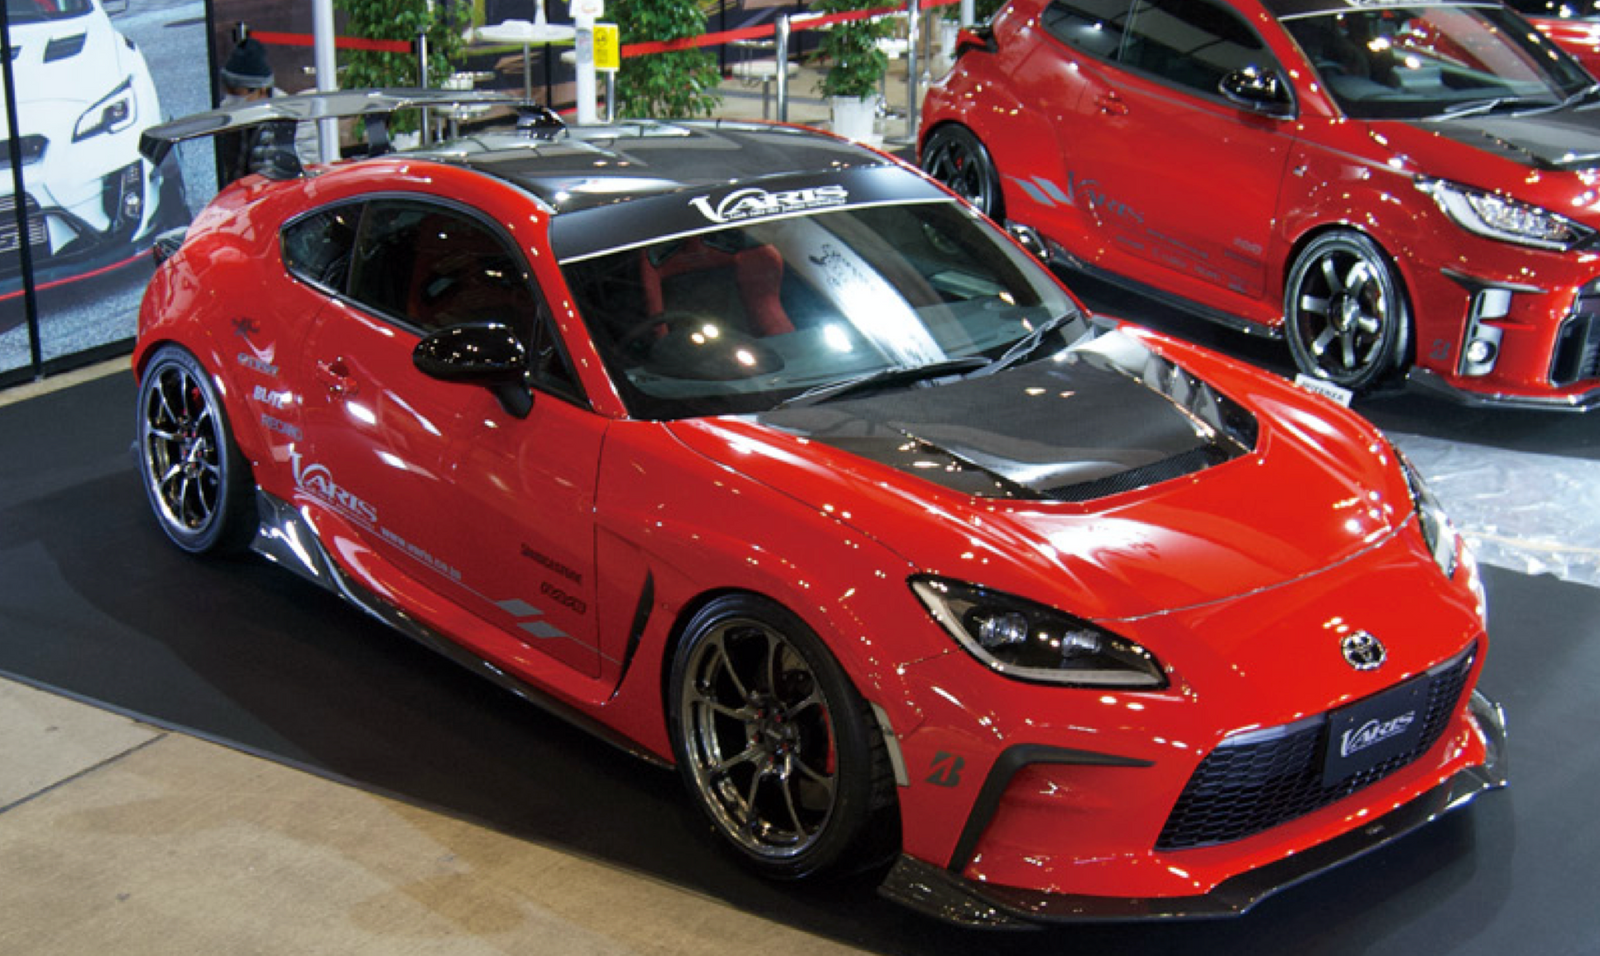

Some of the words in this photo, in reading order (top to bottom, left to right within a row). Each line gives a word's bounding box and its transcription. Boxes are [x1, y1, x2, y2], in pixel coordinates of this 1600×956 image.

[688, 185, 848, 223] VARIS
[290, 445, 377, 523] VARIS
[1340, 710, 1416, 758] VARIS
